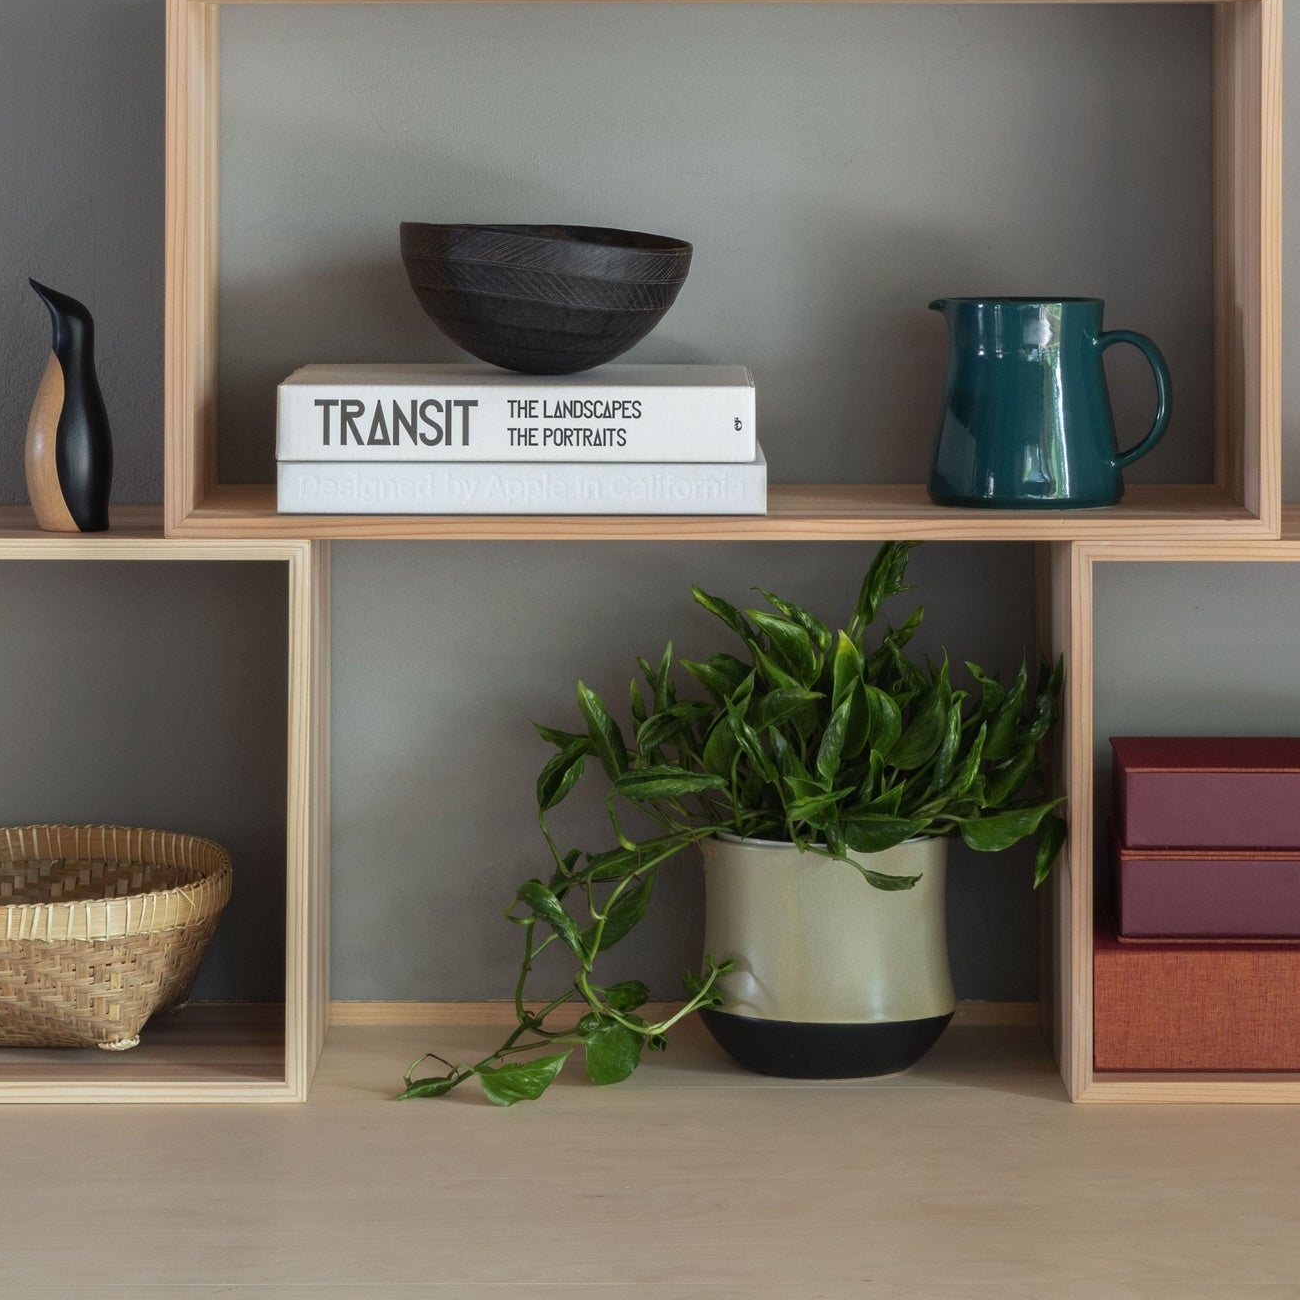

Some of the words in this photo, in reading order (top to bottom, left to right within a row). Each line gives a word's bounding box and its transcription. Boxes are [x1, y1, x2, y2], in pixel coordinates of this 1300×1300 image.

[507, 400, 539, 419] THE
[543, 400, 642, 419] LANDSCAPES
[314, 399, 479, 447] TRANSIT
[507, 428, 539, 446] THE
[543, 428, 627, 447] PORTRAITS
[300, 473, 434, 503] Designed
[447, 473, 480, 504] by
[484, 474, 567, 504] Apple
[576, 474, 601, 501] in
[610, 474, 744, 501] California
